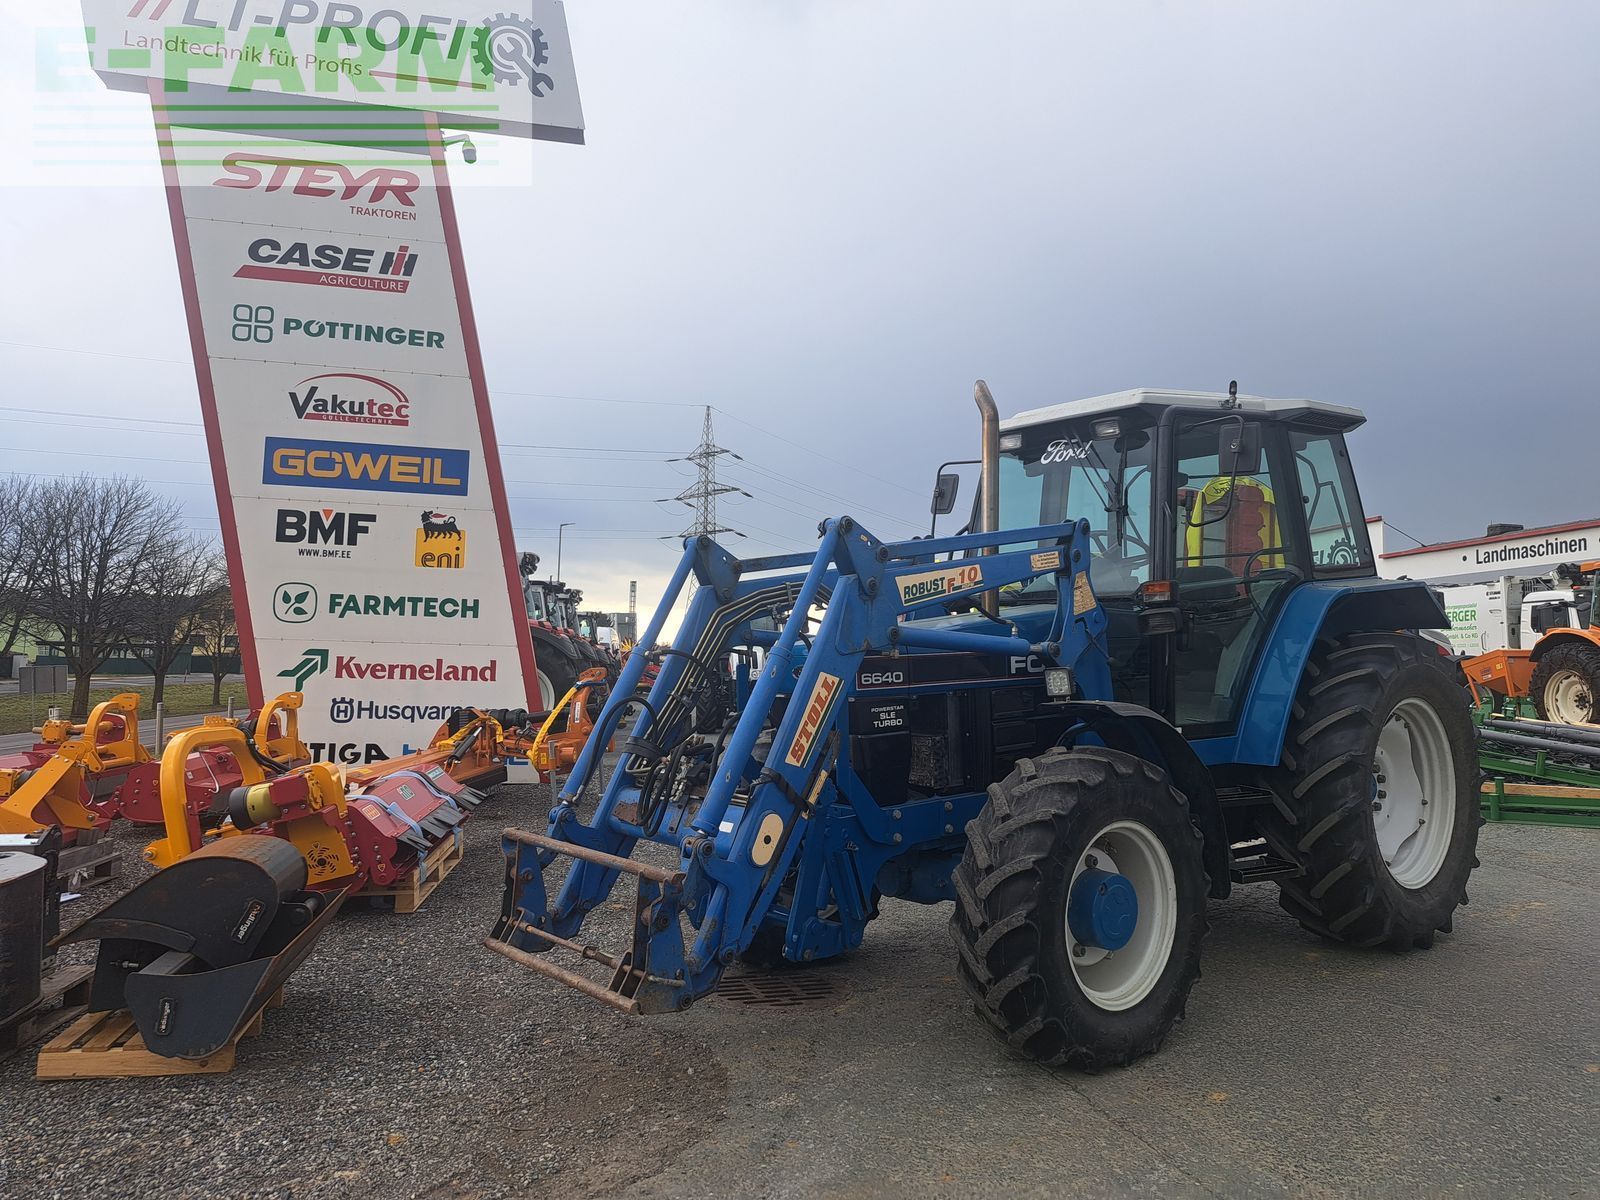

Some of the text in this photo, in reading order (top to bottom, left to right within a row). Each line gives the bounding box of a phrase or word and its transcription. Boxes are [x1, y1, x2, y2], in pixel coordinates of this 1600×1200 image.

[124, 30, 363, 76] Landtechnik für Profis
[212, 152, 420, 207] STEYR
[350, 205, 417, 221] TRAKTOREN
[247, 238, 375, 273] CASE
[319, 274, 404, 291] AGRICULTURE
[283, 317, 445, 349] PÖTTINGER
[288, 386, 410, 419] Vakutec
[1040, 439, 1093, 465] Ford
[275, 508, 377, 547] BMF
[298, 548, 352, 559] WWW.BMF.EE
[420, 546, 461, 569] eni
[1475, 537, 1588, 565] Landmaschinen
[903, 577, 946, 599] ROBUST
[328, 593, 480, 619] FARMTECH
[335, 656, 497, 682] Kverneland
[861, 671, 904, 685] 6640
[790, 675, 836, 764] STOLL
[870, 704, 905, 713] POWERSTAR
[879, 711, 896, 720] SLE
[873, 718, 903, 728] TURBO
[304, 742, 390, 764] TIGA
